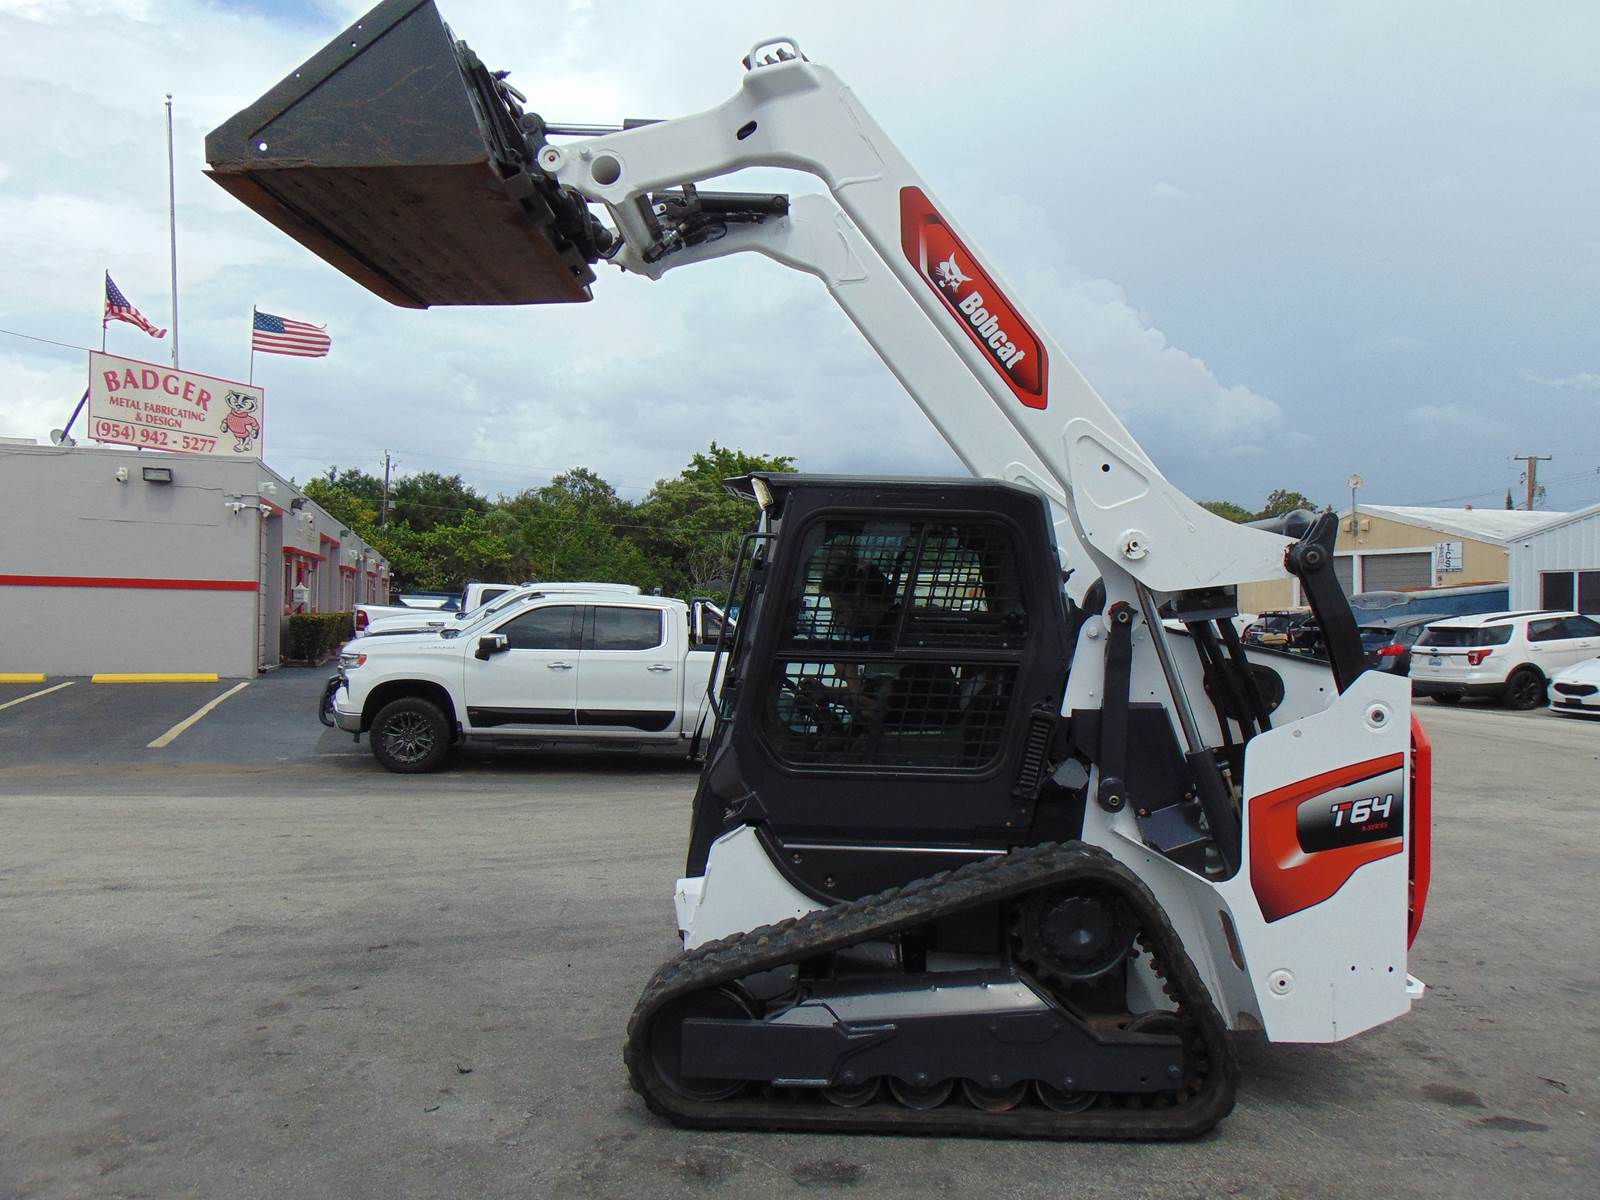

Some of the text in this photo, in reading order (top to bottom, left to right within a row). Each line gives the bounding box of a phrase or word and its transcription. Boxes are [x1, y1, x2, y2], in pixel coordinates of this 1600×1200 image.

[959, 291, 1025, 370] Bobcat
[103, 369, 212, 411] BADGER
[109, 396, 206, 422] METAL FABRICATING
[135, 413, 182, 428] & DESIGN
[95, 419, 136, 442] (954)
[140, 428, 168, 446] 942
[182, 436, 216, 453] 5277
[1331, 795, 1393, 827] T64
